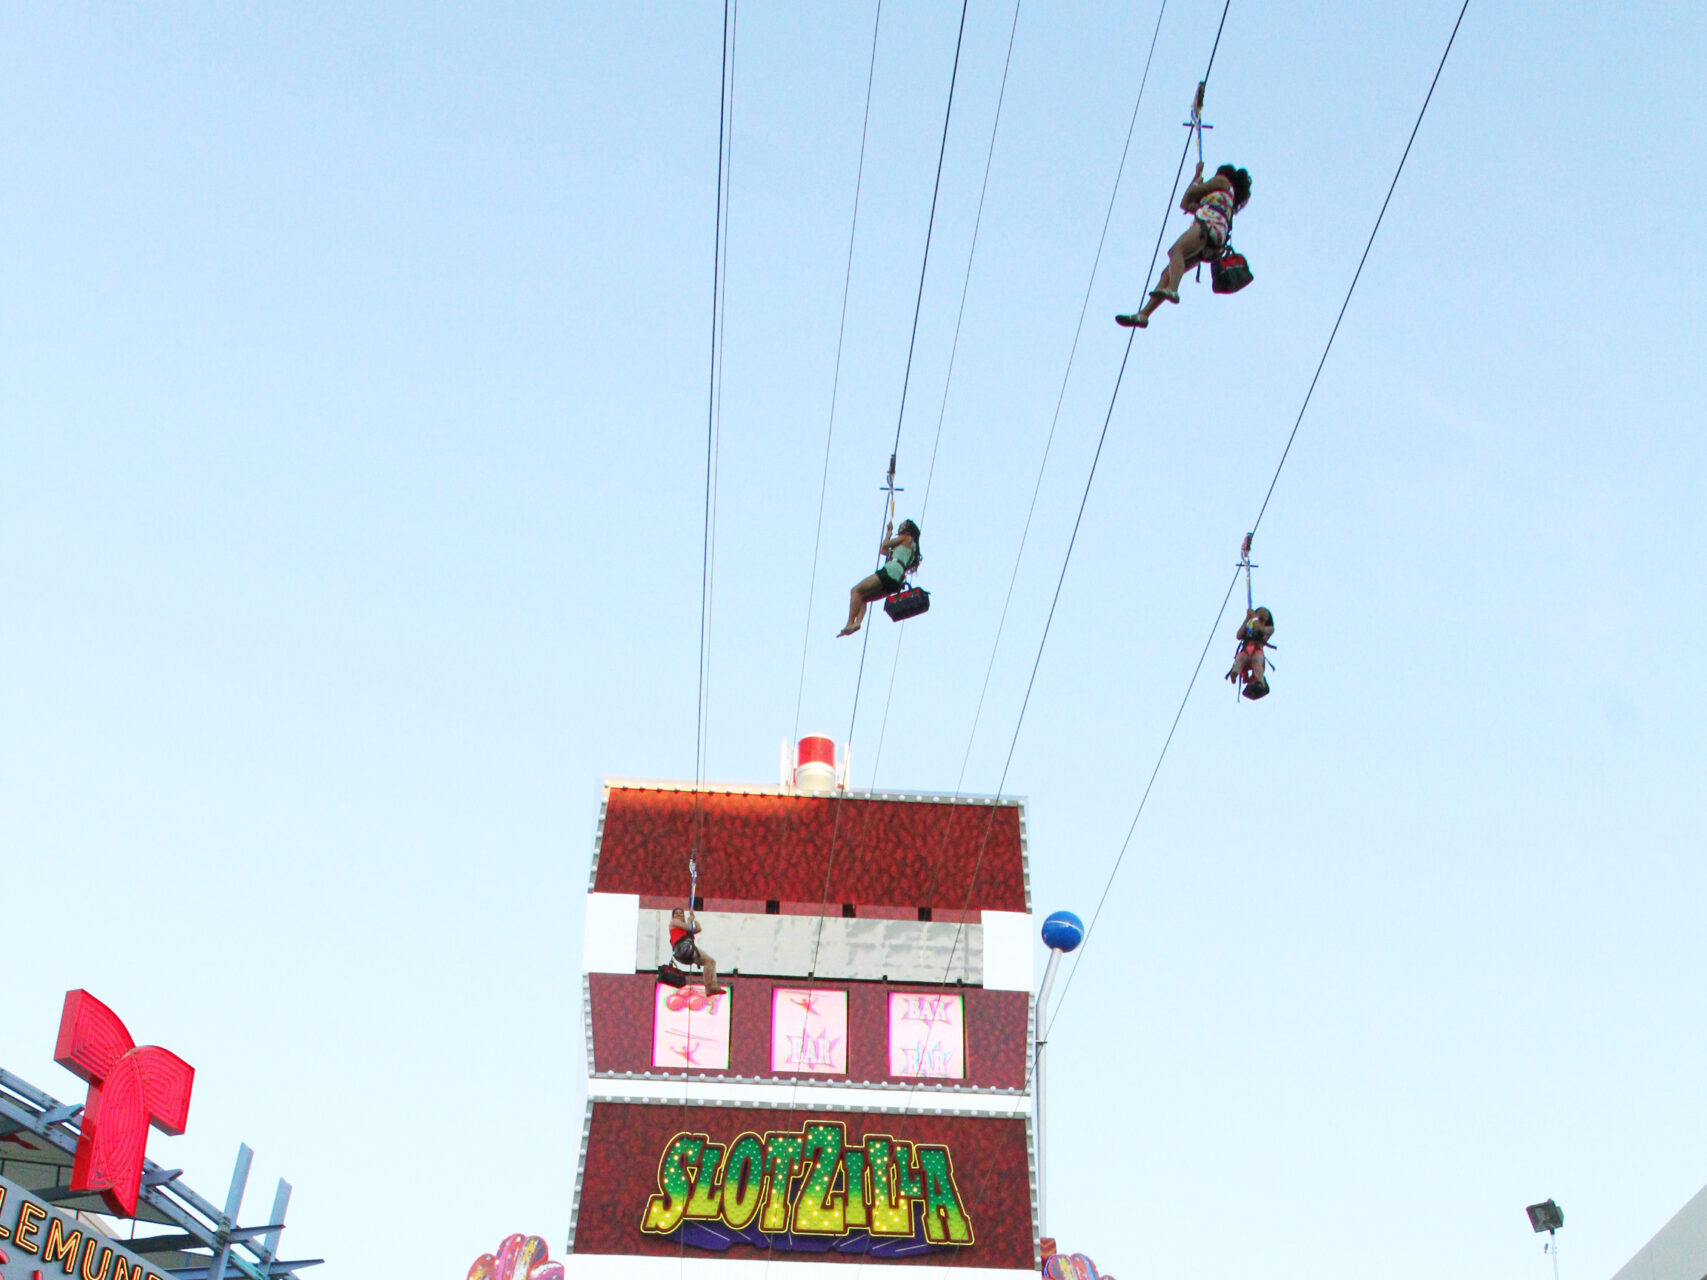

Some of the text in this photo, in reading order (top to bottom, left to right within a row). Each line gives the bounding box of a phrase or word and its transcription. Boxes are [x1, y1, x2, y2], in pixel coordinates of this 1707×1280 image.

[788, 1036, 832, 1066] BAR
[905, 1048, 947, 1077] BAR
[640, 1120, 975, 1246] SLOTZILLA
